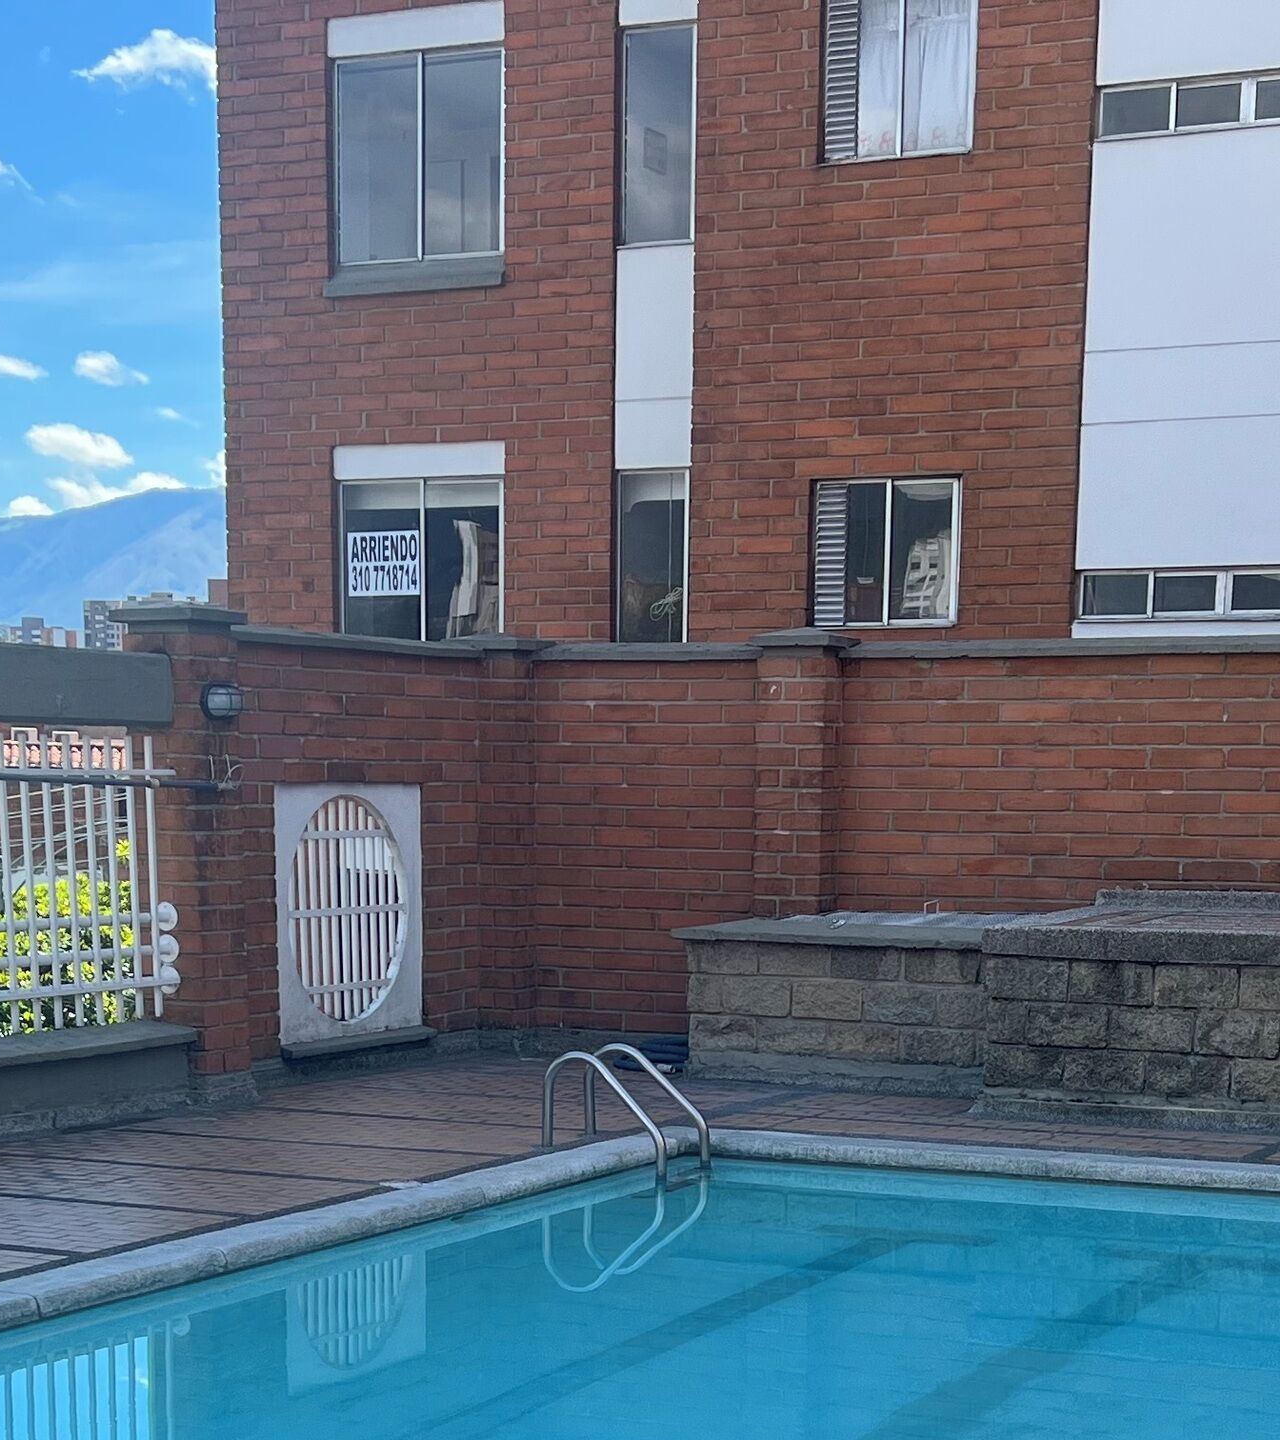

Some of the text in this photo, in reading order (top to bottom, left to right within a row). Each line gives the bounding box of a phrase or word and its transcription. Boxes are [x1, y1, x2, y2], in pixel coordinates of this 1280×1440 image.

[351, 533, 417, 563] ARRIENDO
[351, 563, 417, 592] 310 7718714
